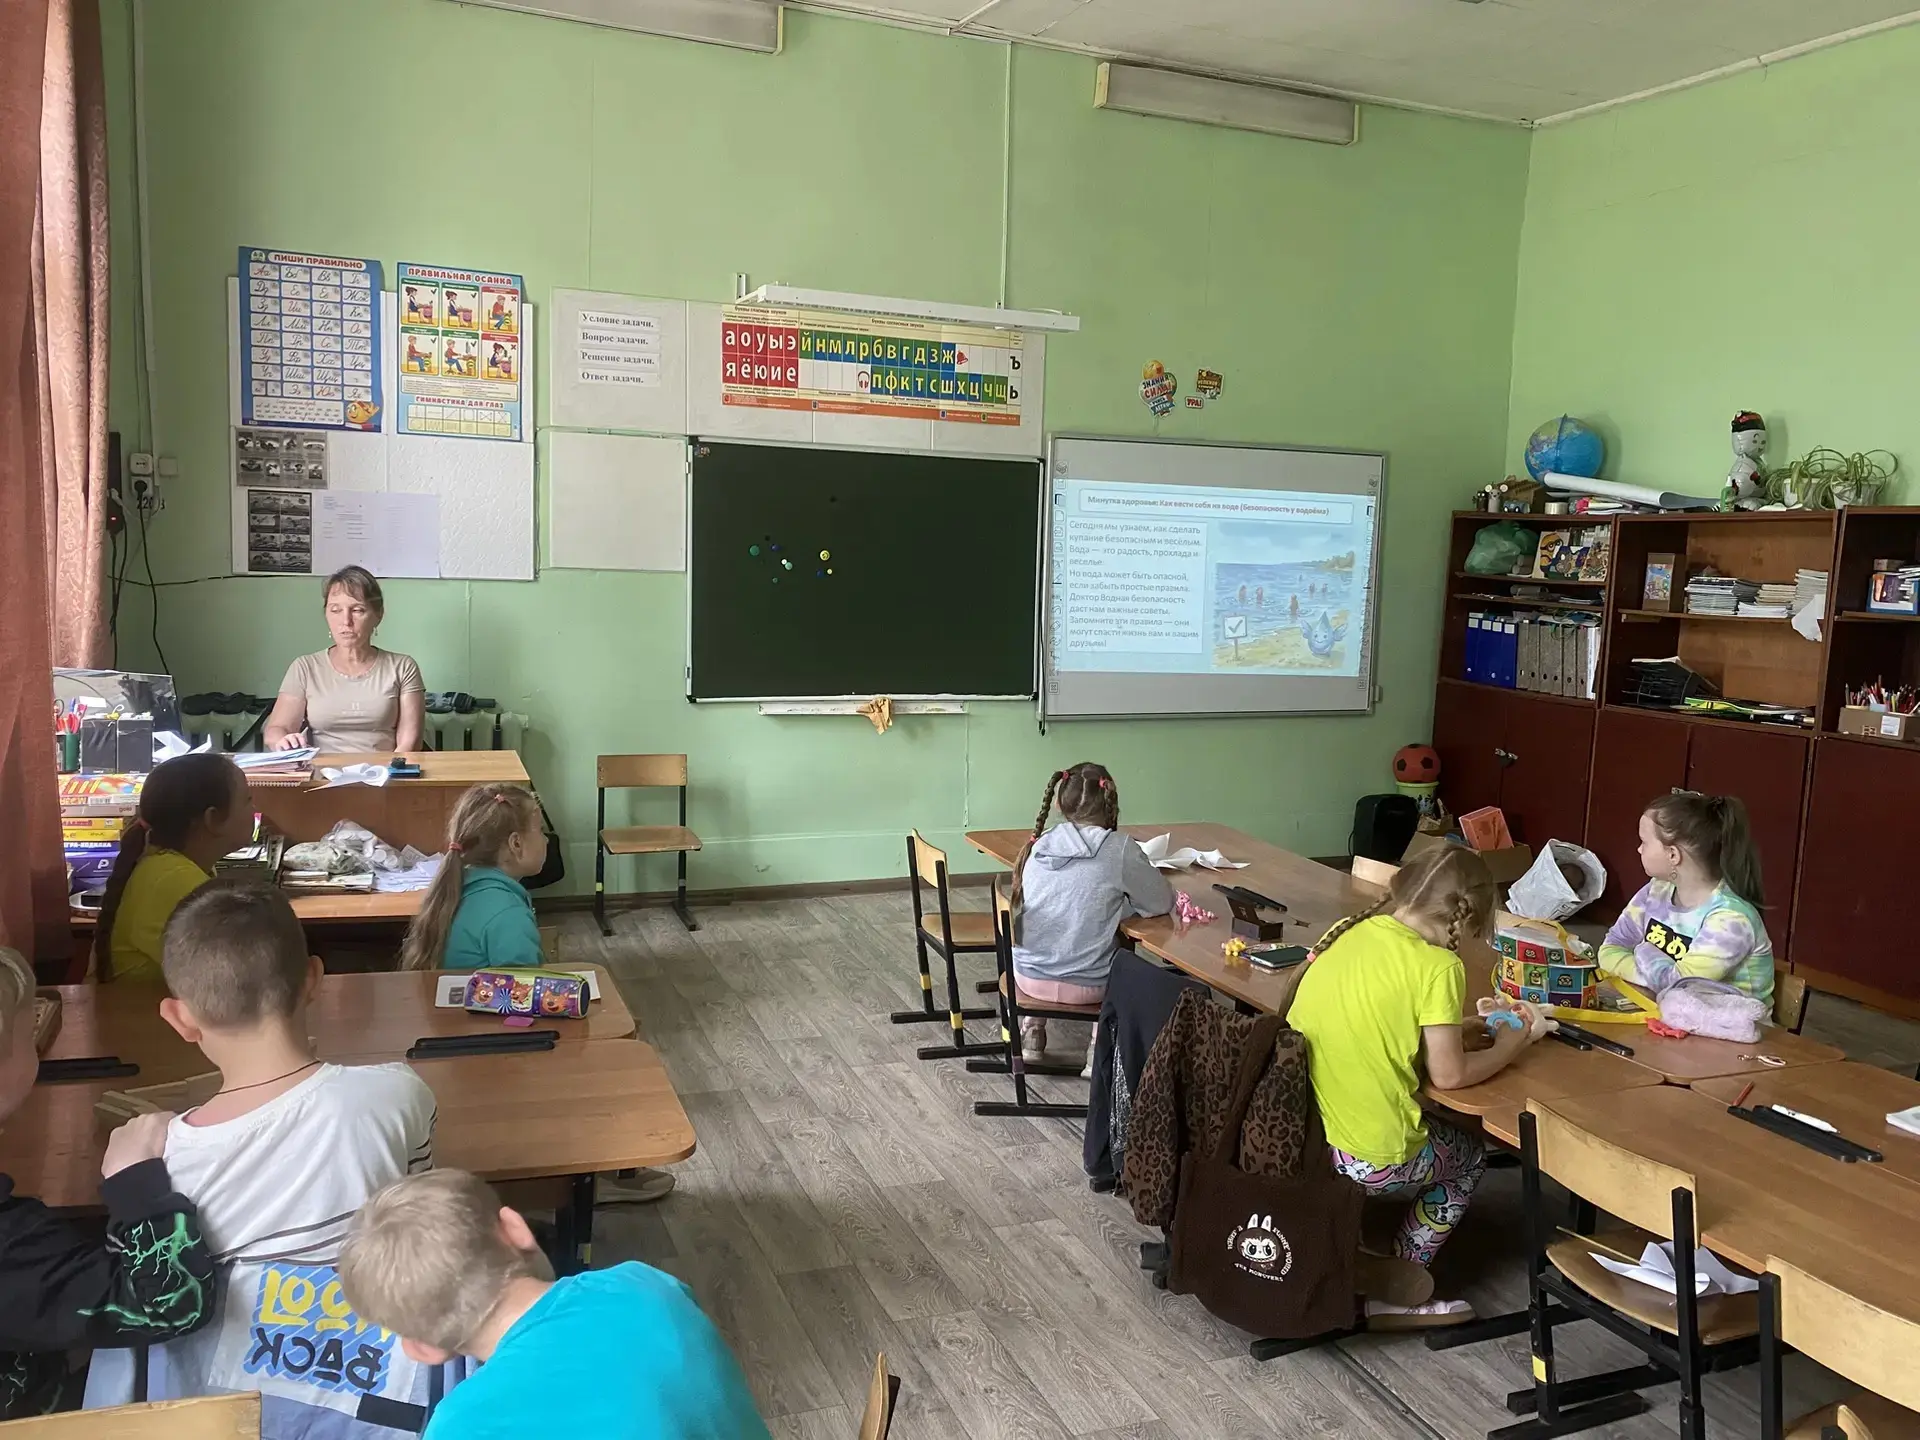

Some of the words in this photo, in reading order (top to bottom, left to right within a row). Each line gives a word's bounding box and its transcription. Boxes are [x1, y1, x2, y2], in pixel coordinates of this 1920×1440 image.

[274, 254, 304, 263] ПИШИ
[306, 257, 363, 268] ПРАВИЛЬНО
[408, 268, 471, 281] ПРАВИЛЬНАЯ
[475, 276, 512, 285] ОСАНКА
[582, 313, 620, 324] Условие
[622, 320, 654, 328] задачи.
[582, 332, 614, 343] Вопрос
[581, 352, 621, 362] Решение
[623, 356, 654, 365] задачи.
[582, 372, 609, 381] Ответ
[416, 396, 465, 406] ГИМНАСТИКА
[1088, 496, 1120, 505] Минутка
[1240, 503, 1290, 513] (Безопасность
[1070, 521, 1103, 530] Сегодня
[1105, 534, 1156, 544] безопасным
[1070, 546, 1089, 554] Вода
[1154, 550, 1191, 558] прохлада
[1132, 571, 1152, 580] быть
[1153, 573, 1188, 581] опасной,
[1090, 582, 1119, 590] забыть
[1120, 584, 1154, 592] простые
[1069, 593, 1099, 602] Доктор
[1101, 594, 1130, 602] Водная
[1131, 594, 1185, 604] безопасность
[1272, 1227, 1290, 1251] FUNNY
[1248, 1268, 1284, 1282] MONSTERS
